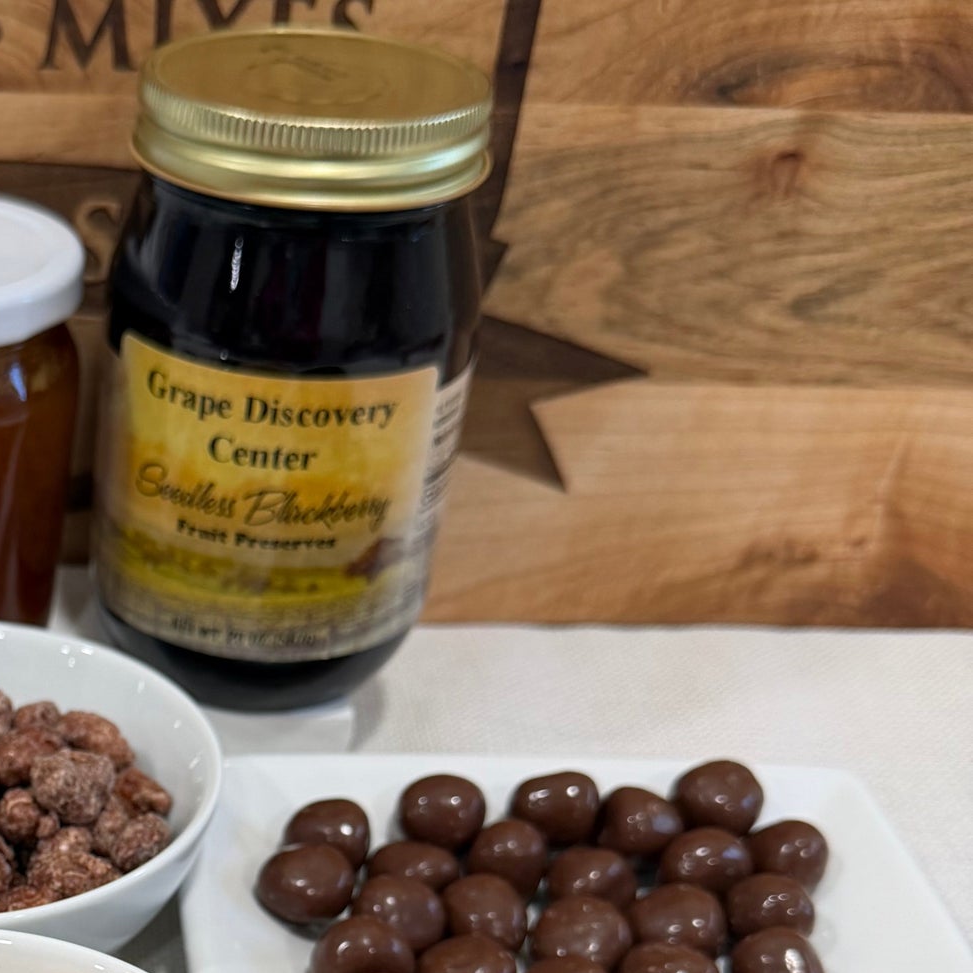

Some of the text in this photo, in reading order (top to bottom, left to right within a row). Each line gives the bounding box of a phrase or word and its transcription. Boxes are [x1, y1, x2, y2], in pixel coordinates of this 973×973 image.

[146, 368, 398, 429] Grape Discovery
[207, 433, 318, 471] Center
[135, 461, 391, 533] Seedless Blackberry
[176, 518, 228, 545] Fruit
